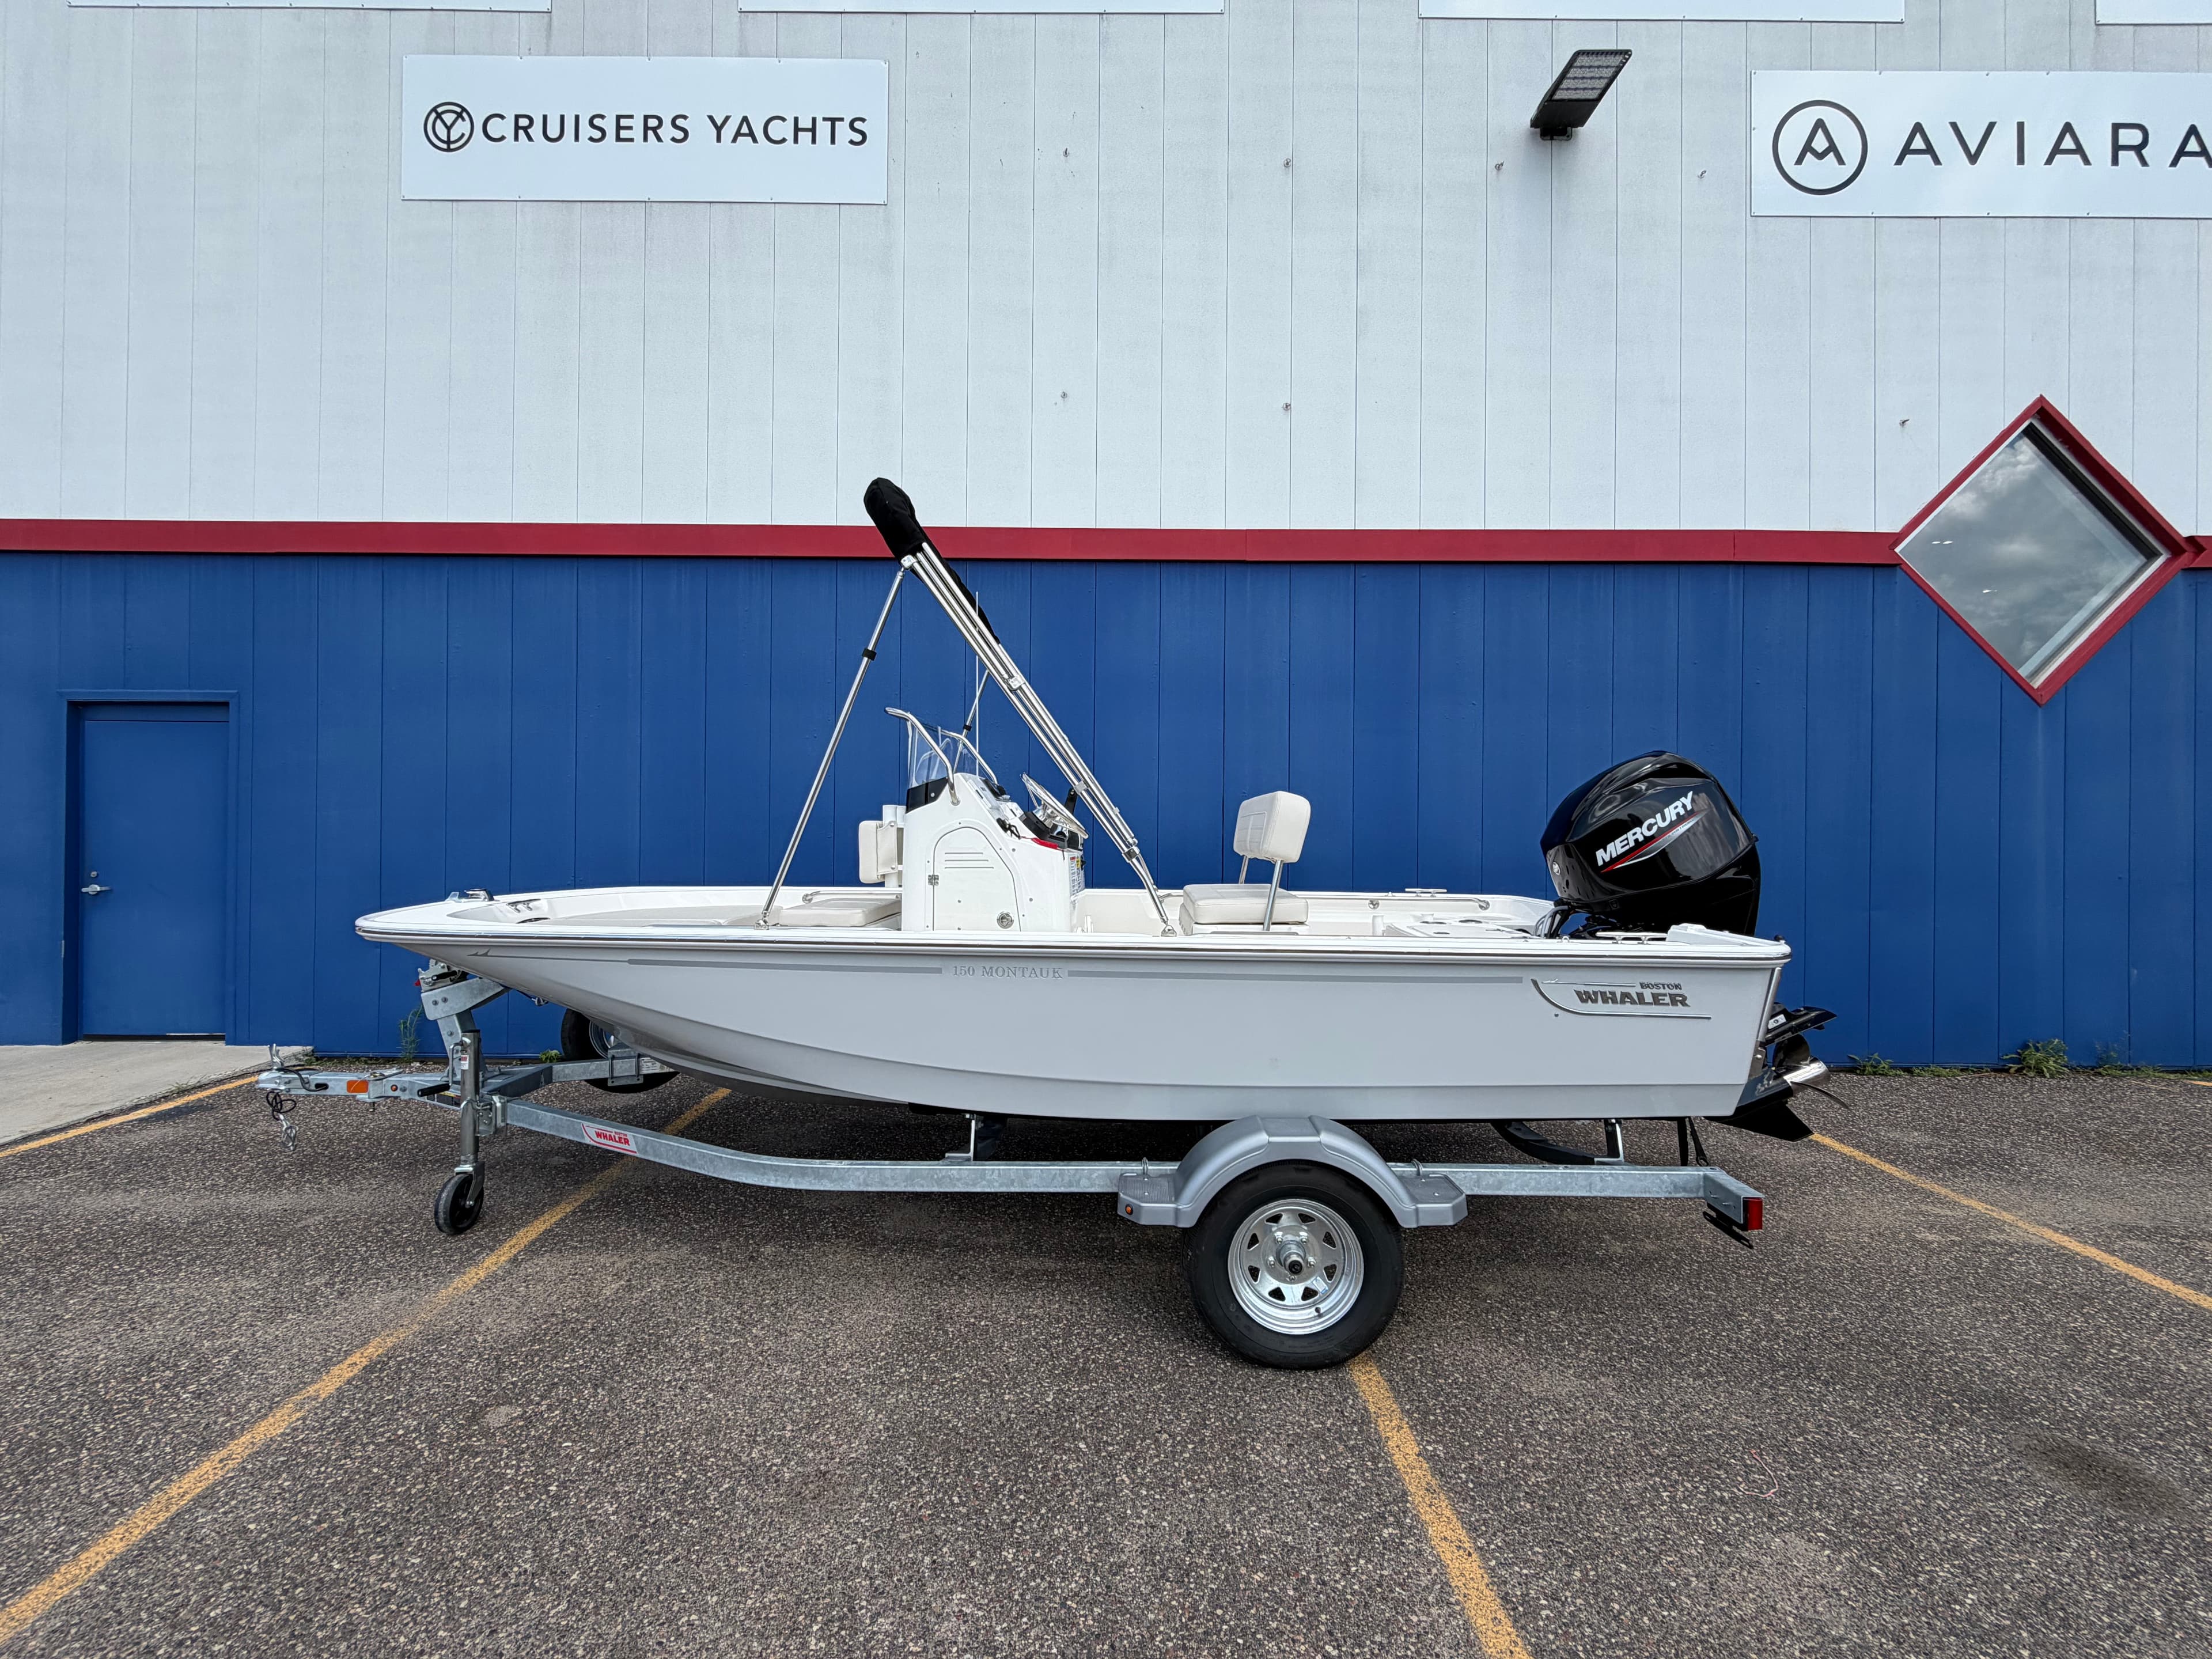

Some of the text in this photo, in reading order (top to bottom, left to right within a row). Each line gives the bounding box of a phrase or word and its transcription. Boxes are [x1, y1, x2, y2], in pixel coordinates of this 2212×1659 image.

[482, 113, 868, 146] CRUISERS YACHTS
[1893, 121, 2212, 169] AVIARA
[1595, 790, 1694, 866] MERCURY
[953, 965, 1063, 979] 150 MONTAUK
[1639, 982, 1682, 991] BOSTON
[1573, 989, 1691, 1008] WHALER
[594, 1130, 630, 1146] WHALER
